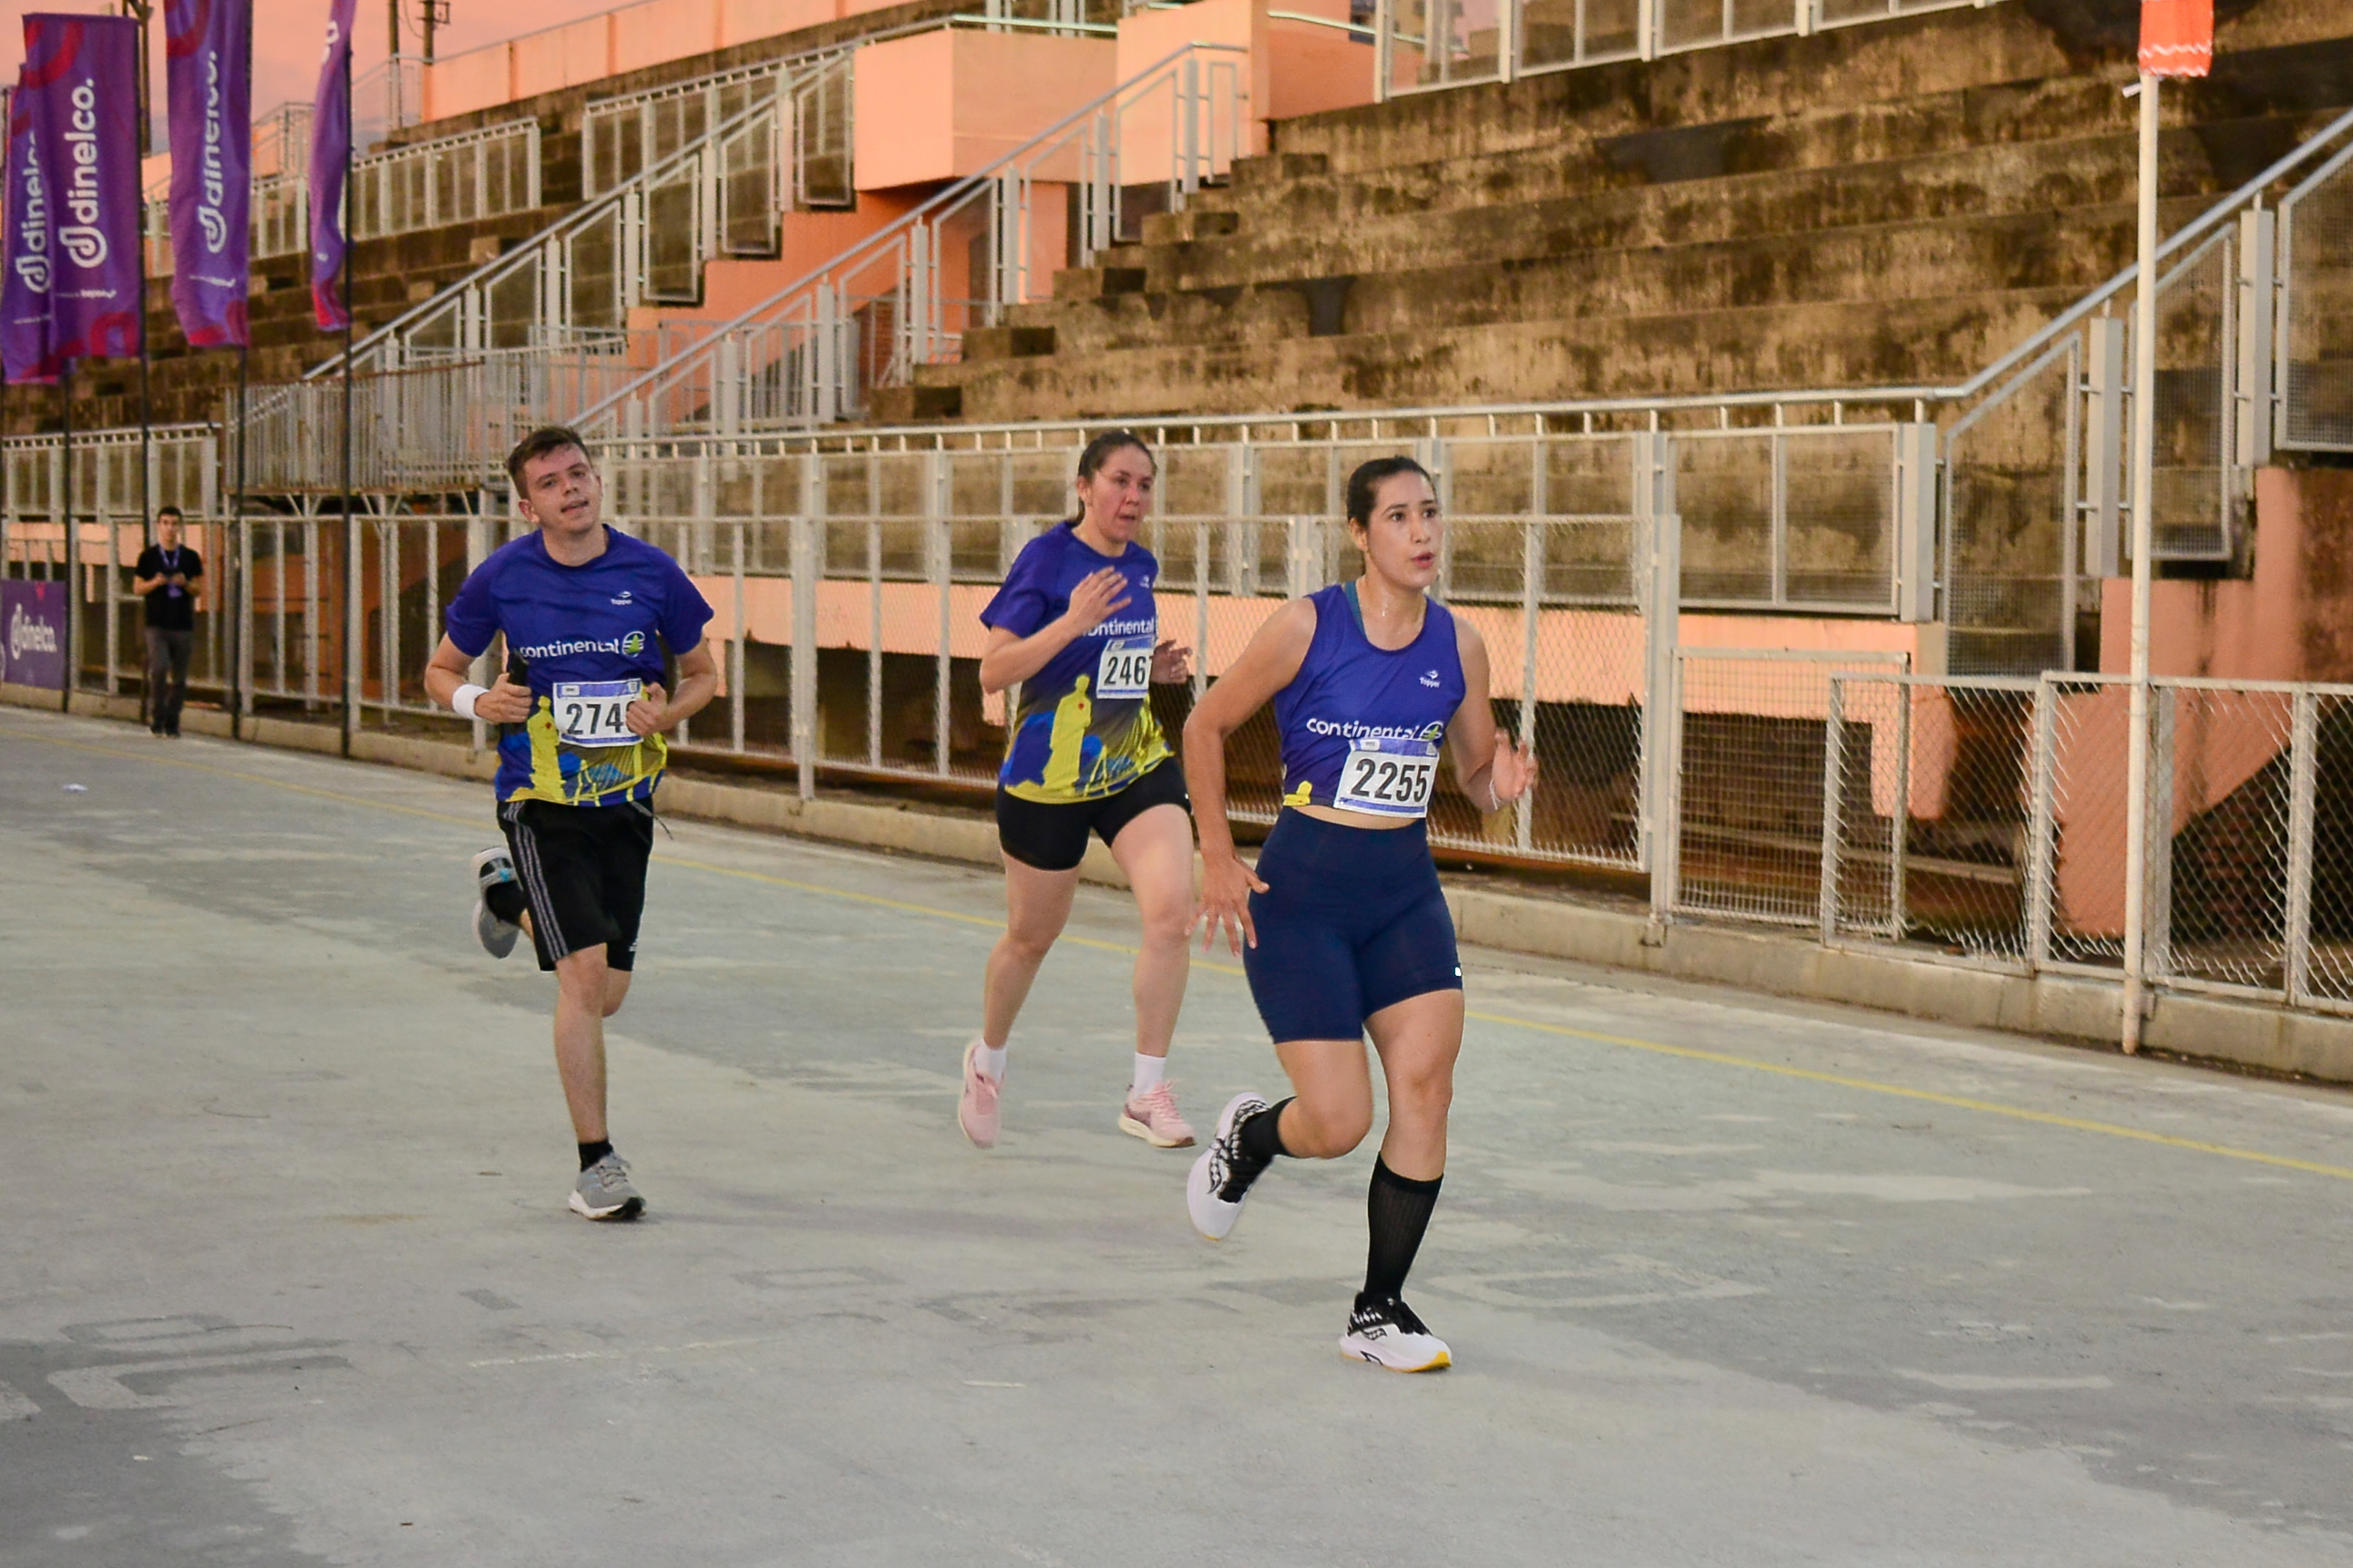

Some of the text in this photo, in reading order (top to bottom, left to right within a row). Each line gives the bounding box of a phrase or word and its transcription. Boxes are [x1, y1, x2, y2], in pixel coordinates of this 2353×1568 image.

[64, 77, 98, 224] dinelco.
[519, 639, 620, 658] continental
[1103, 655, 1154, 686] 246
[1306, 717, 1420, 739] continental
[1350, 758, 1431, 803] 2255
